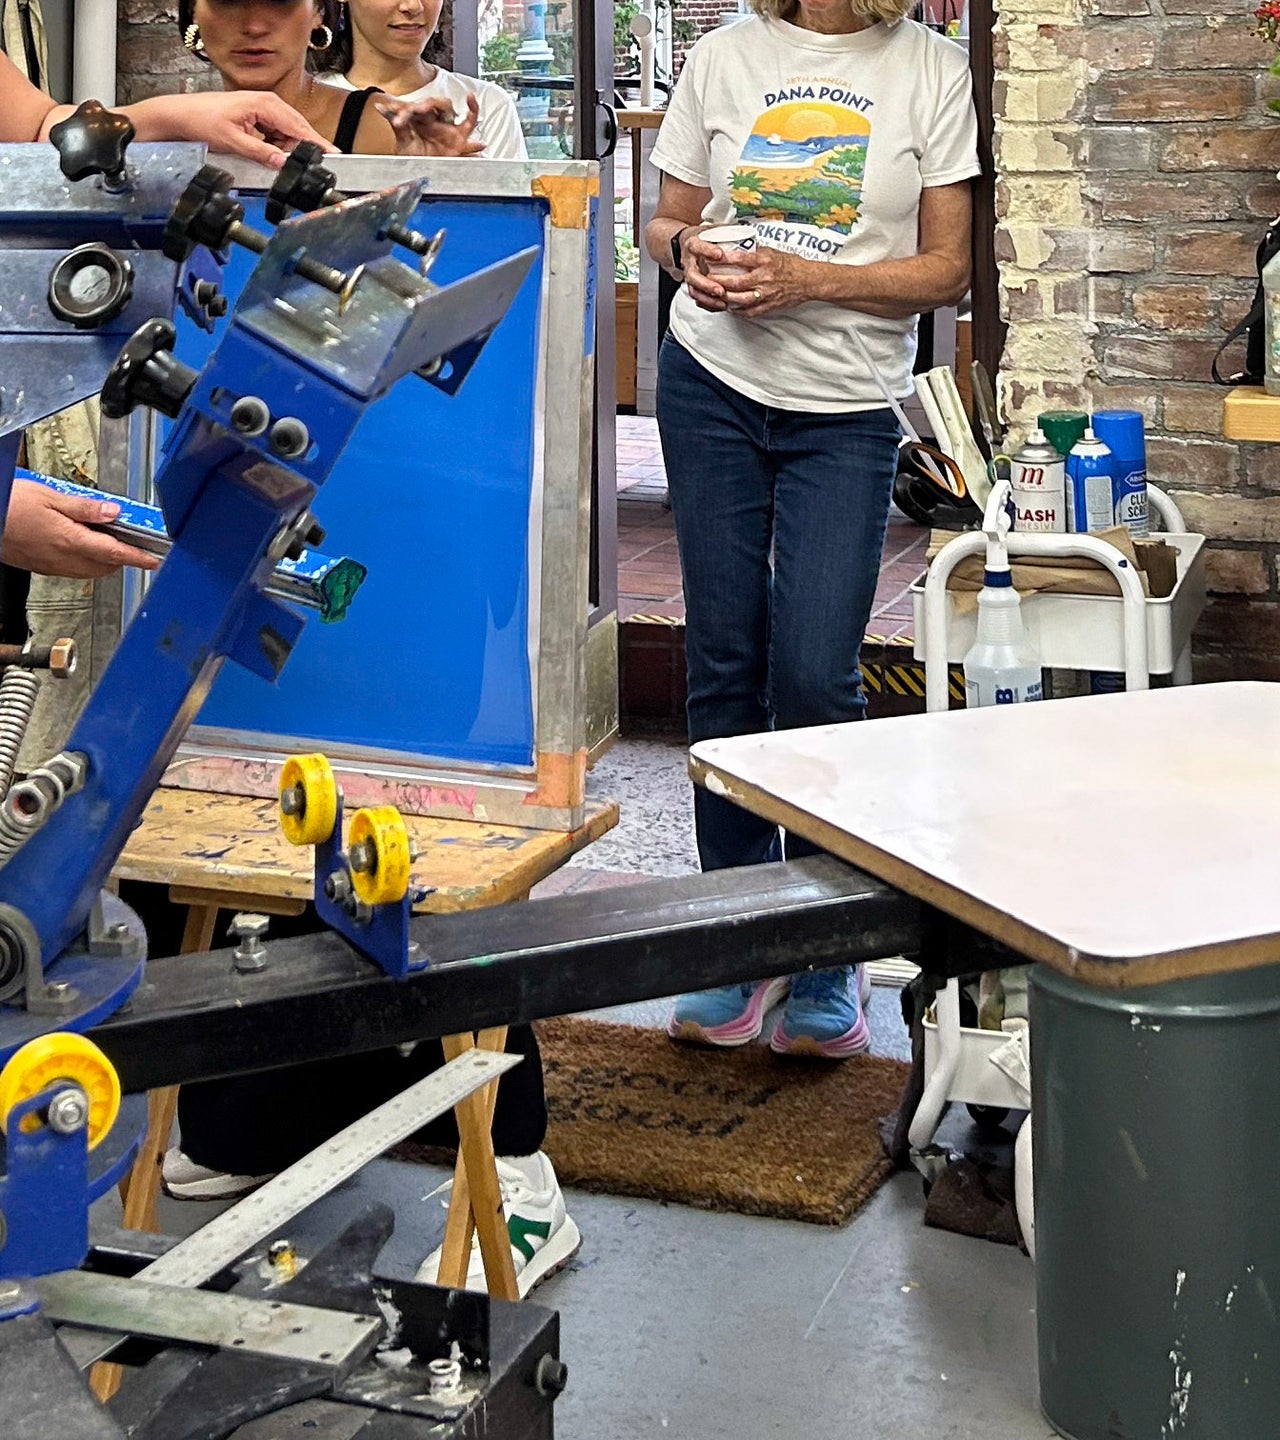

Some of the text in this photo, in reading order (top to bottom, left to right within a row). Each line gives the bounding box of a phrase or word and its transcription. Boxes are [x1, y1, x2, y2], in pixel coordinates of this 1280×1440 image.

[764, 86, 874, 113] DANA POINT
[798, 231, 843, 256] TROT
[1016, 507, 1056, 522] LASH
